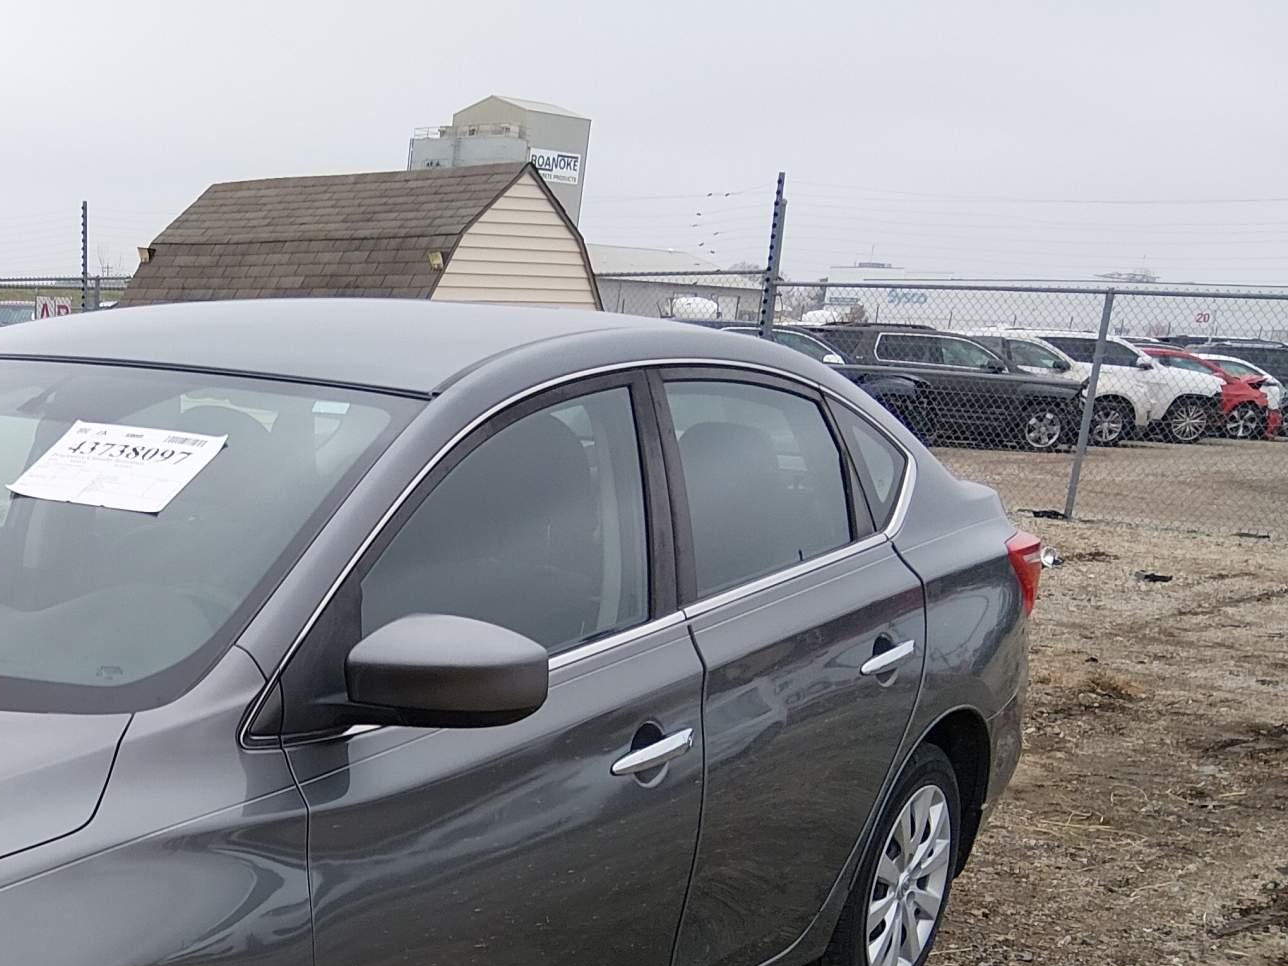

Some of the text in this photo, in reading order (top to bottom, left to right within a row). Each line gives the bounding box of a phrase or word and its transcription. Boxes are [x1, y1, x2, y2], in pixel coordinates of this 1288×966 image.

[531, 154, 579, 172] ROANOKE
[886, 288, 928, 305] Sysco
[1195, 312, 1210, 323] 20
[68, 440, 193, 465] 43738097
